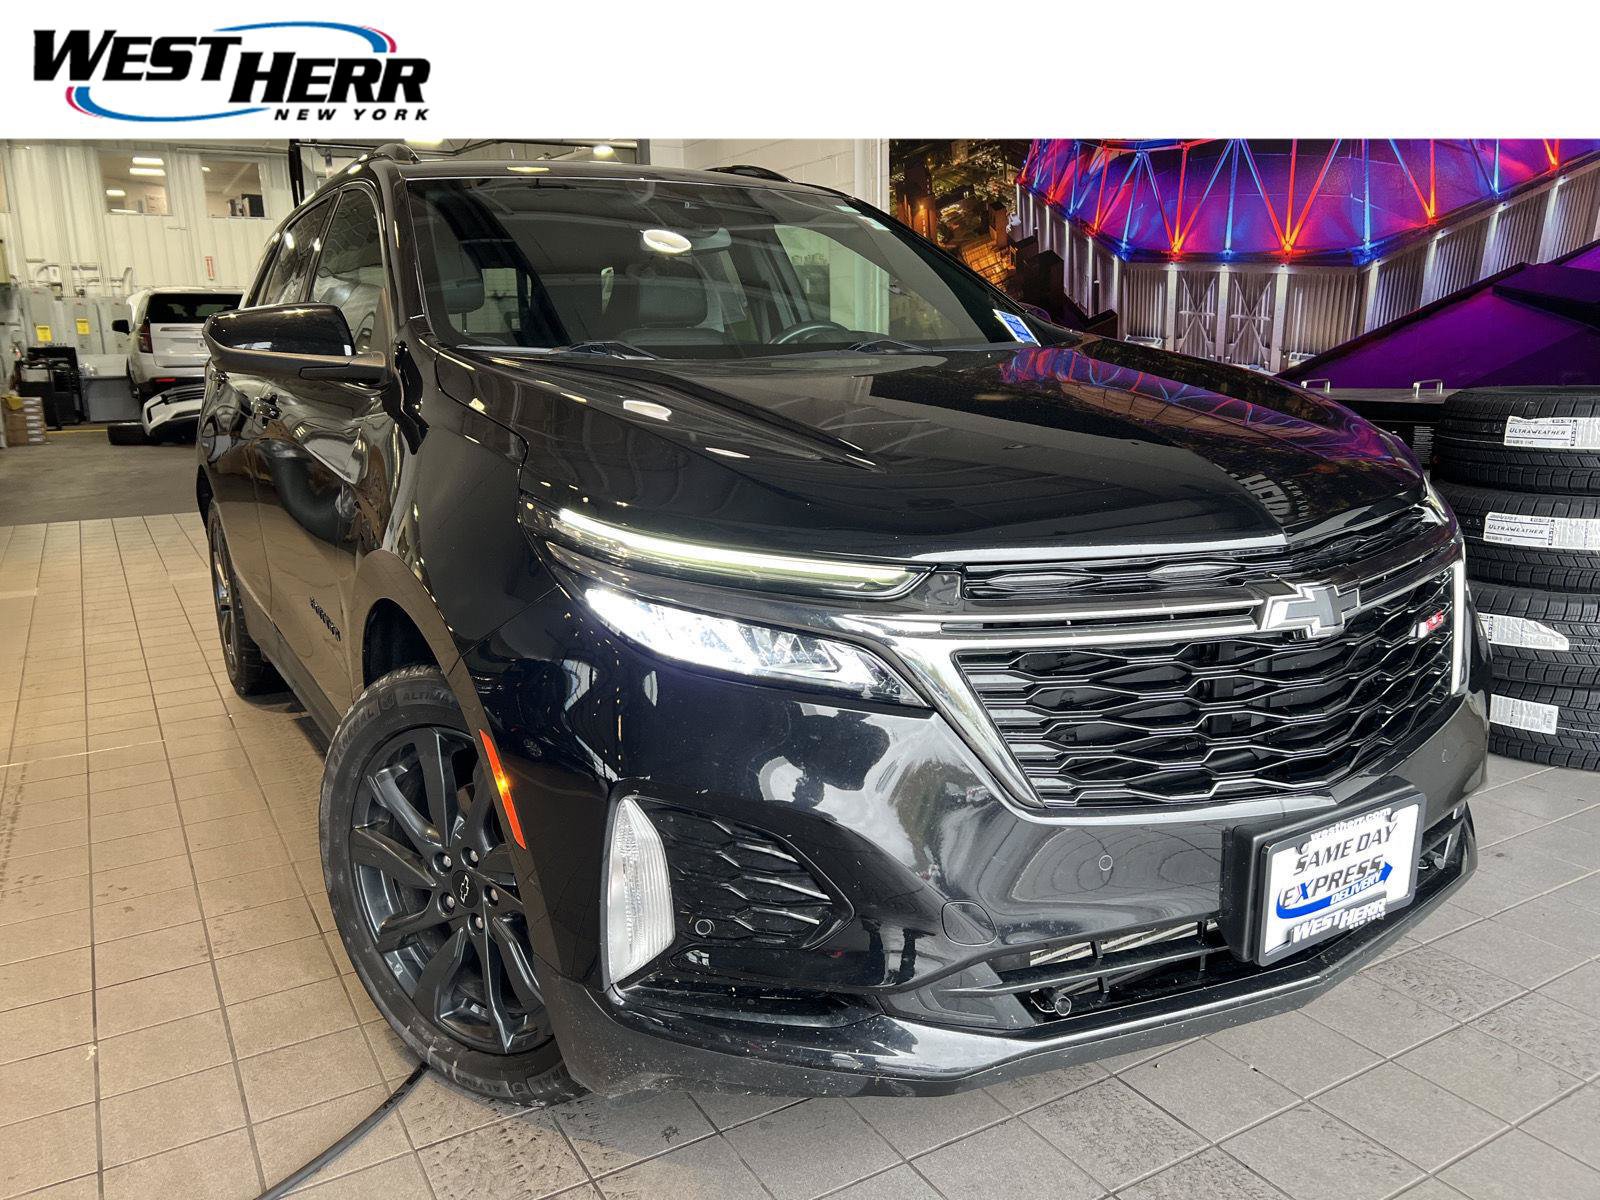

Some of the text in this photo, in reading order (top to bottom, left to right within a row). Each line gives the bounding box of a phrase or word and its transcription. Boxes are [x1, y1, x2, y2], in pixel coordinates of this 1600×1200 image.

[1508, 427, 1567, 437] ULTRAWEATHER
[1487, 523, 1545, 535] ULTRAWEATHER
[1293, 823, 1398, 876] SAME DAY
[1281, 854, 1383, 908] EXPRESS
[1330, 873, 1382, 905] DELIVERY
